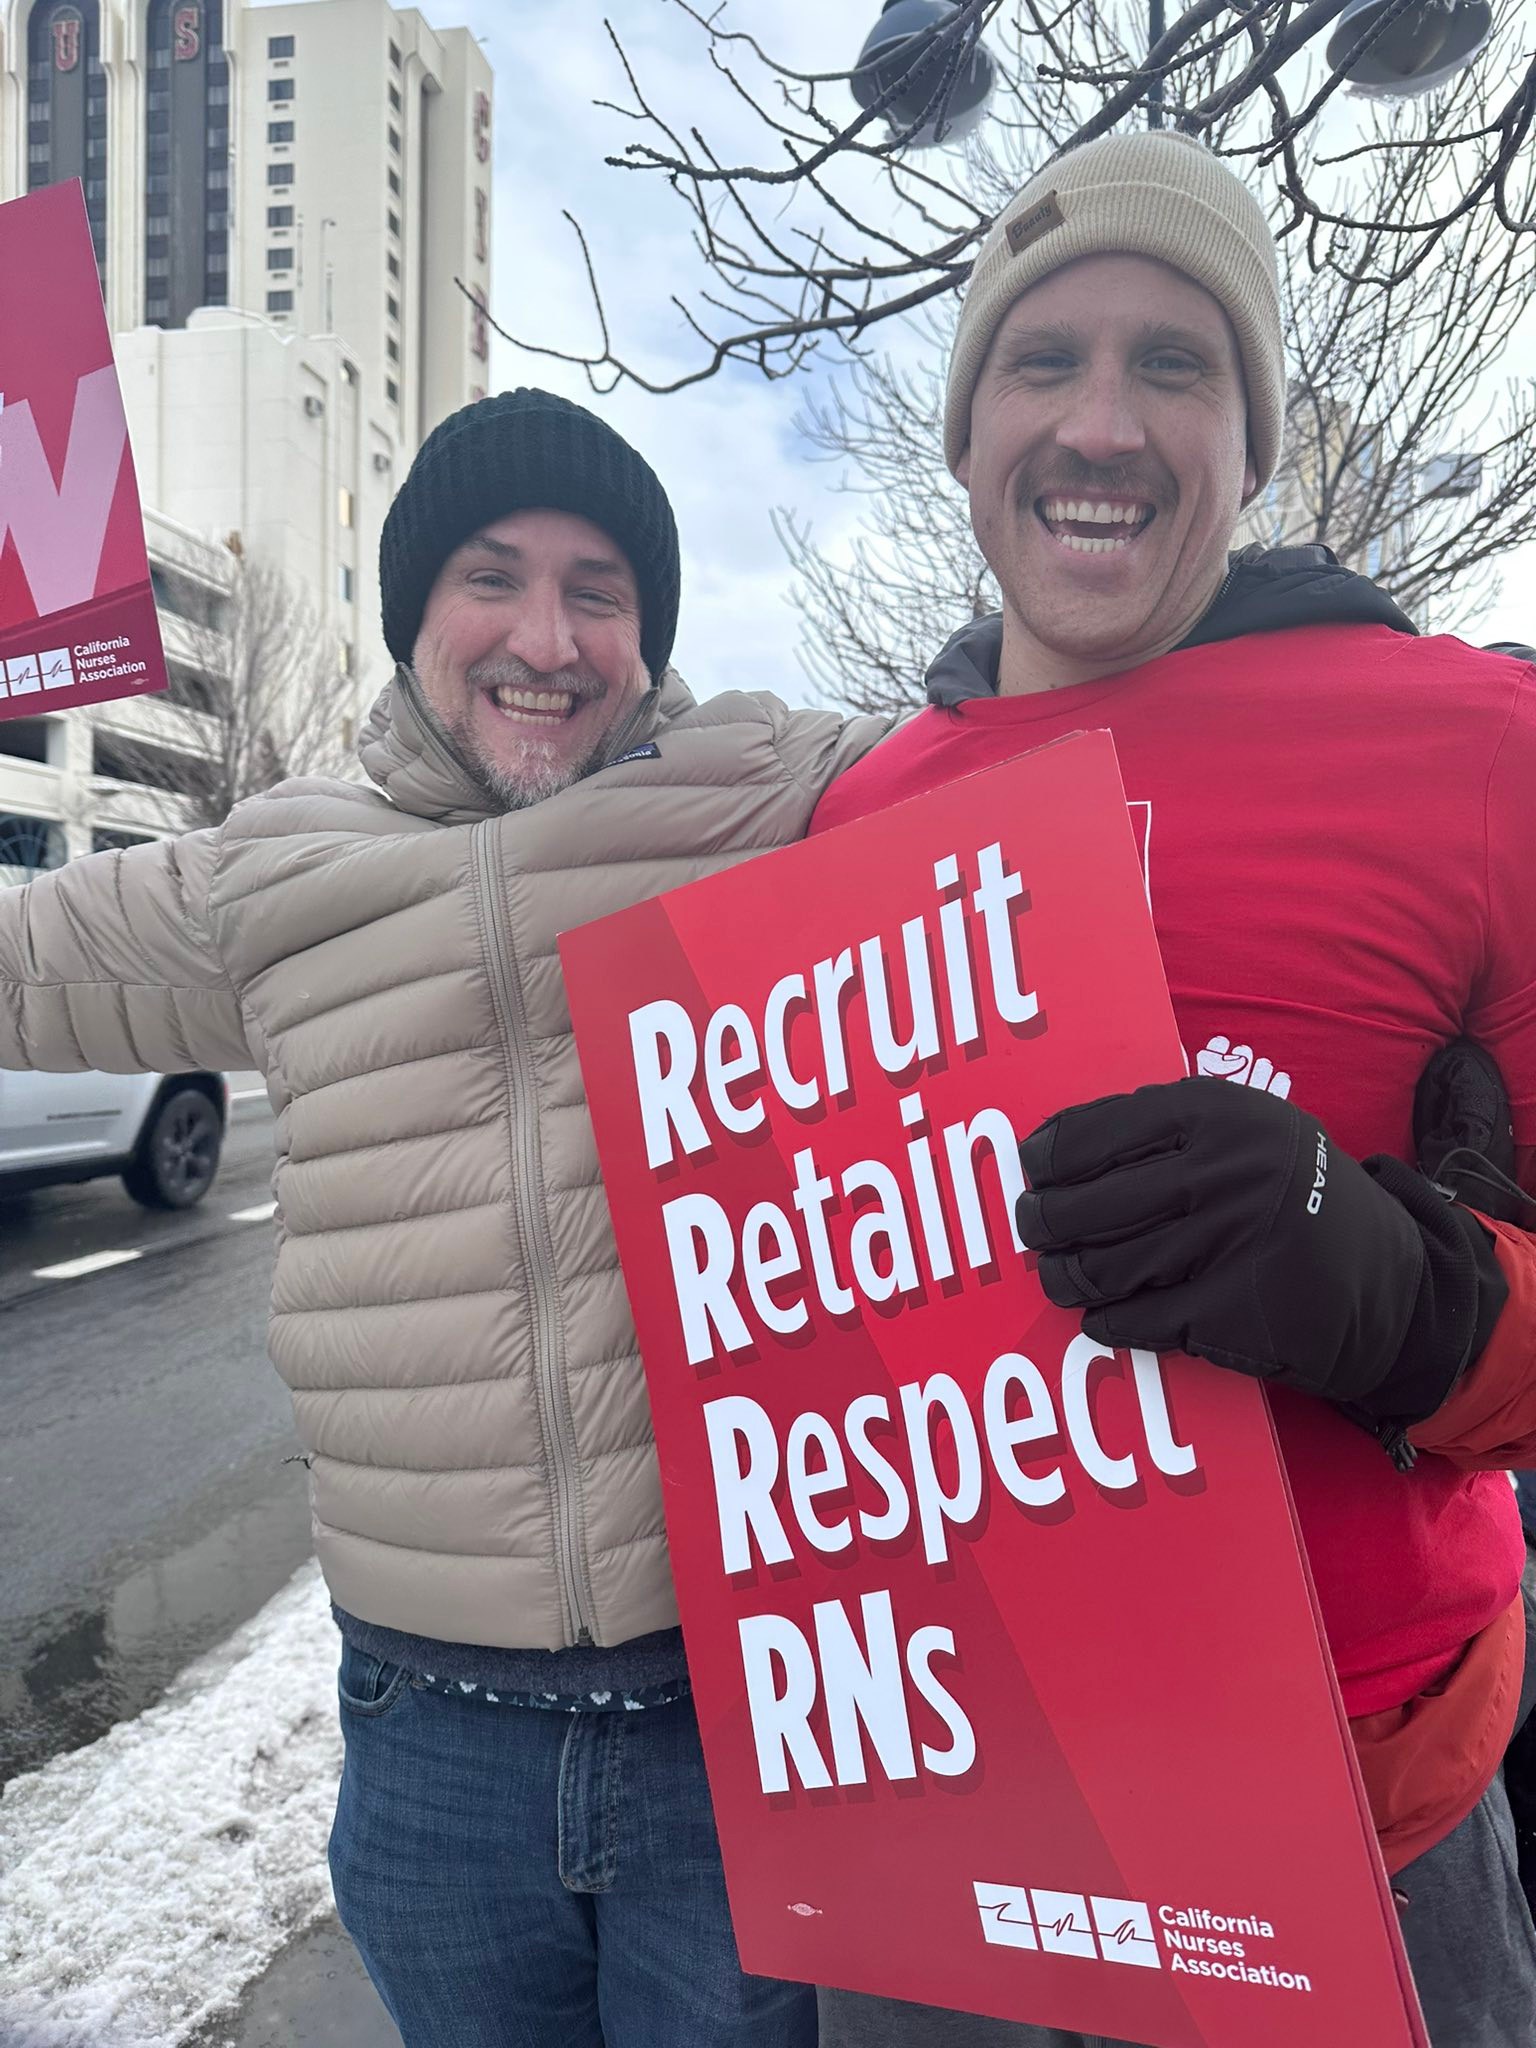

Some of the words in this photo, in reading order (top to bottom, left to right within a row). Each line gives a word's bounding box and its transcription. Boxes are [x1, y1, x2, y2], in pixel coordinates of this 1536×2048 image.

[74, 636, 130, 657] California
[76, 653, 117, 670] Nurses
[79, 660, 147, 684] Association
[627, 841, 1038, 1171] Recruit
[1306, 1131, 1328, 1215] HEAD
[661, 1092, 1029, 1366] Retain
[703, 1333, 1197, 1574] Respect
[738, 1590, 976, 1794] RNs
[1158, 1905, 1275, 1939] California
[1164, 1929, 1246, 1958] Nurses
[1171, 1955, 1312, 1993] Association
